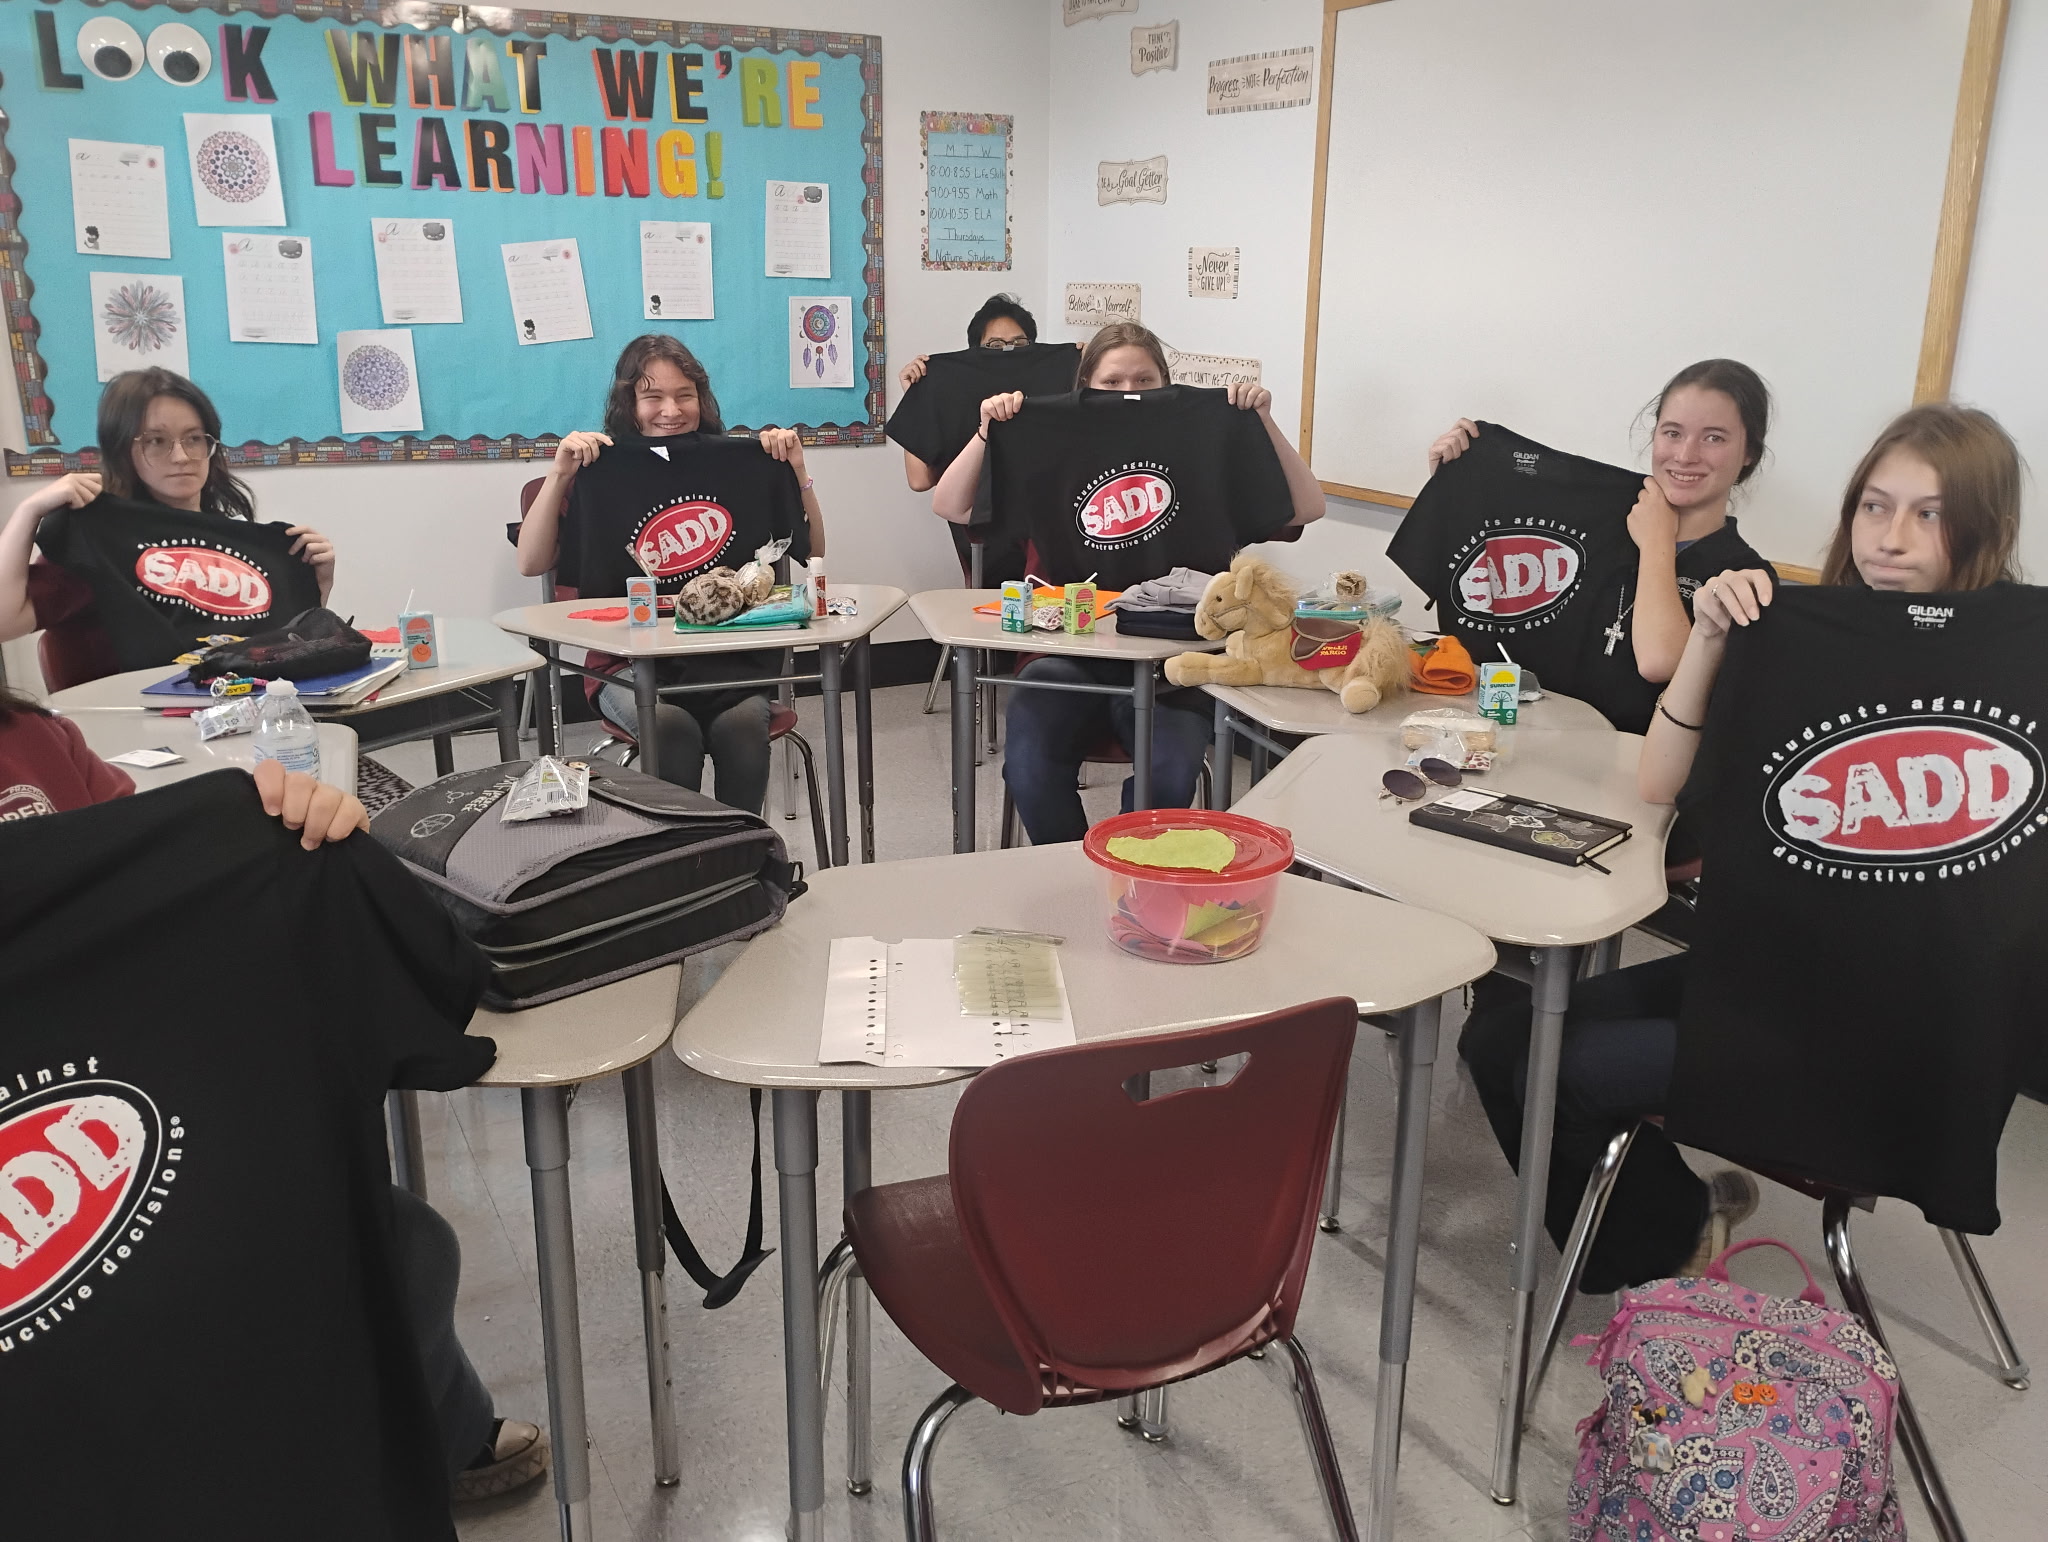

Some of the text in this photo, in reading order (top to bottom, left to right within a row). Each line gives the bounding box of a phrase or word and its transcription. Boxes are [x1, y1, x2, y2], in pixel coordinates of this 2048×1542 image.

[1138, 45, 1169, 64] Positive
[325, 28, 547, 114] WHAT
[592, 48, 824, 129] WE'RE
[1209, 66, 1309, 99] Progress NOT Perfection
[309, 112, 725, 199] LEARNING!
[945, 144, 992, 157] M T W
[975, 187, 999, 200] Math
[1117, 169, 1138, 195] Goal
[1138, 167, 1163, 193] Getter
[974, 207, 992, 220] ELA
[943, 227, 985, 244] Thursdays
[935, 248, 996, 262] Nature Studies
[1199, 255, 1229, 275] Never
[1200, 276, 1226, 291] GIVE UP!
[1104, 295, 1132, 317] Yourself
[1513, 452, 1540, 460] GILDAN
[1074, 460, 1169, 508] students against
[630, 494, 717, 540] tudents against
[1081, 479, 1172, 536] SADD
[640, 509, 727, 570] SADD
[1084, 540, 1138, 551] destructive
[1448, 517, 1586, 569] studets against
[144, 553, 269, 607] SADD
[1908, 604, 1954, 618] GILDAN
[1763, 696, 2037, 775] students against
[1778, 748, 2034, 842] SADD
[1772, 844, 1926, 882] destructive
[0, 1056, 98, 1100] ainst
[0, 1095, 146, 1270] DD
